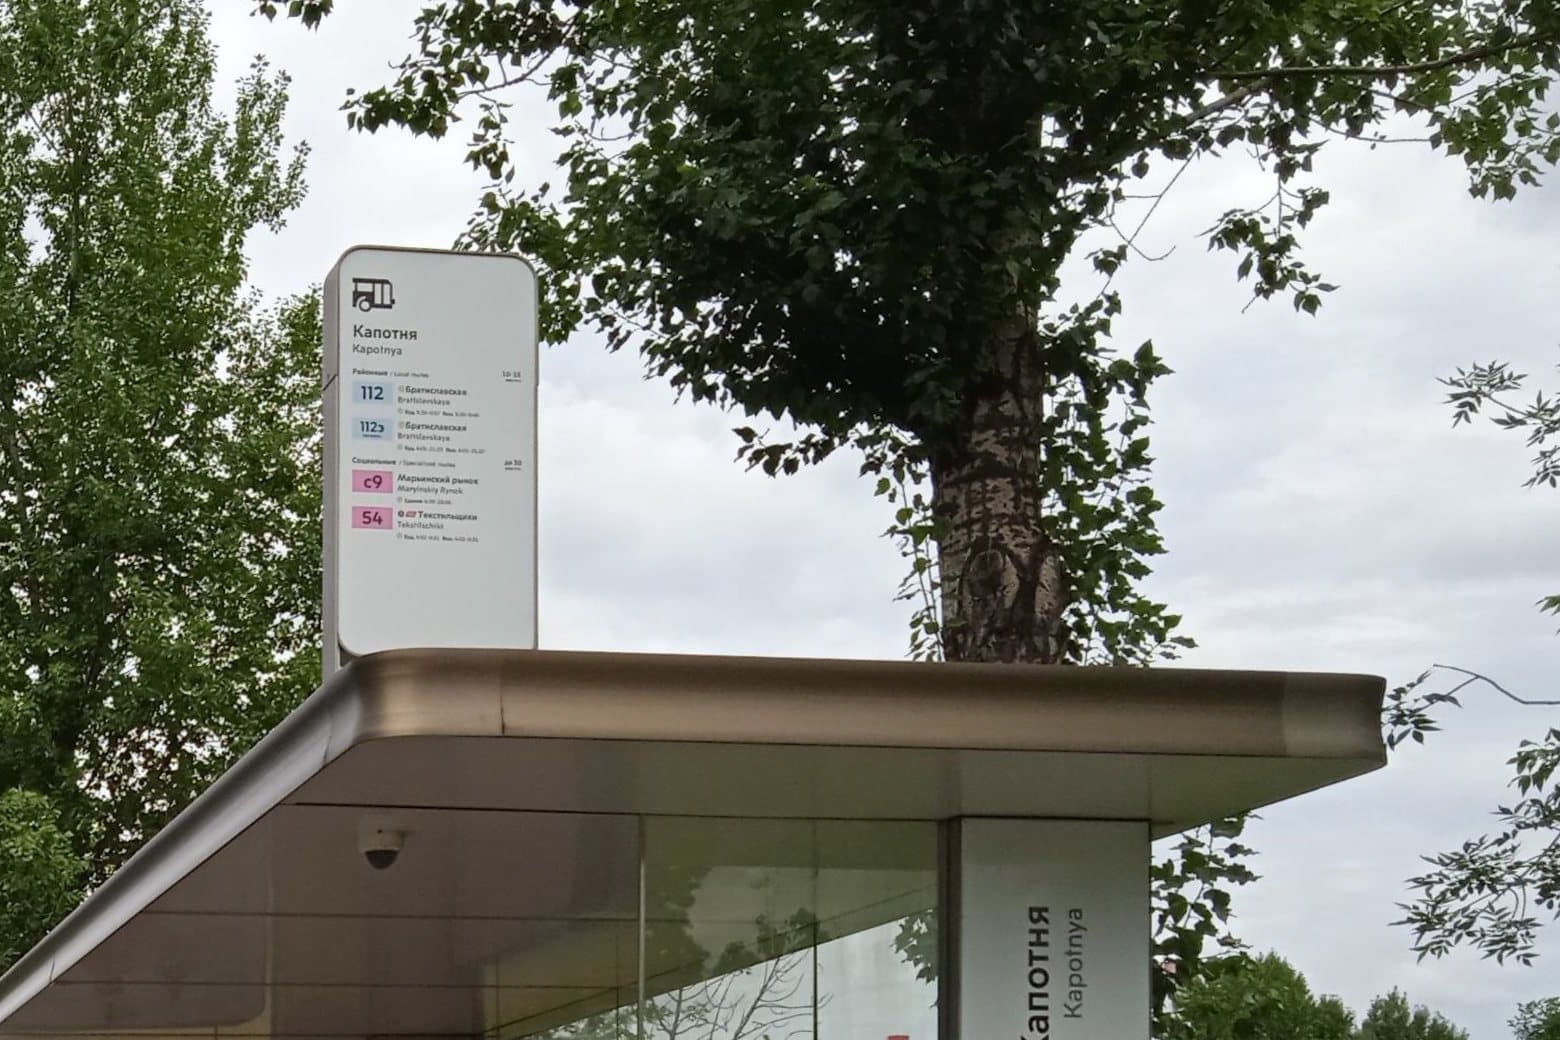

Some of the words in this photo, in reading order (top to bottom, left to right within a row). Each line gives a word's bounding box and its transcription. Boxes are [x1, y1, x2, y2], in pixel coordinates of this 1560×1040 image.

[353, 325, 418, 341] Капотня
[352, 344, 403, 357] Kapotnya
[361, 385, 384, 401] 112
[363, 475, 383, 489] с9
[361, 510, 384, 526] 54
[1063, 907, 1088, 1019] Kapotnya
